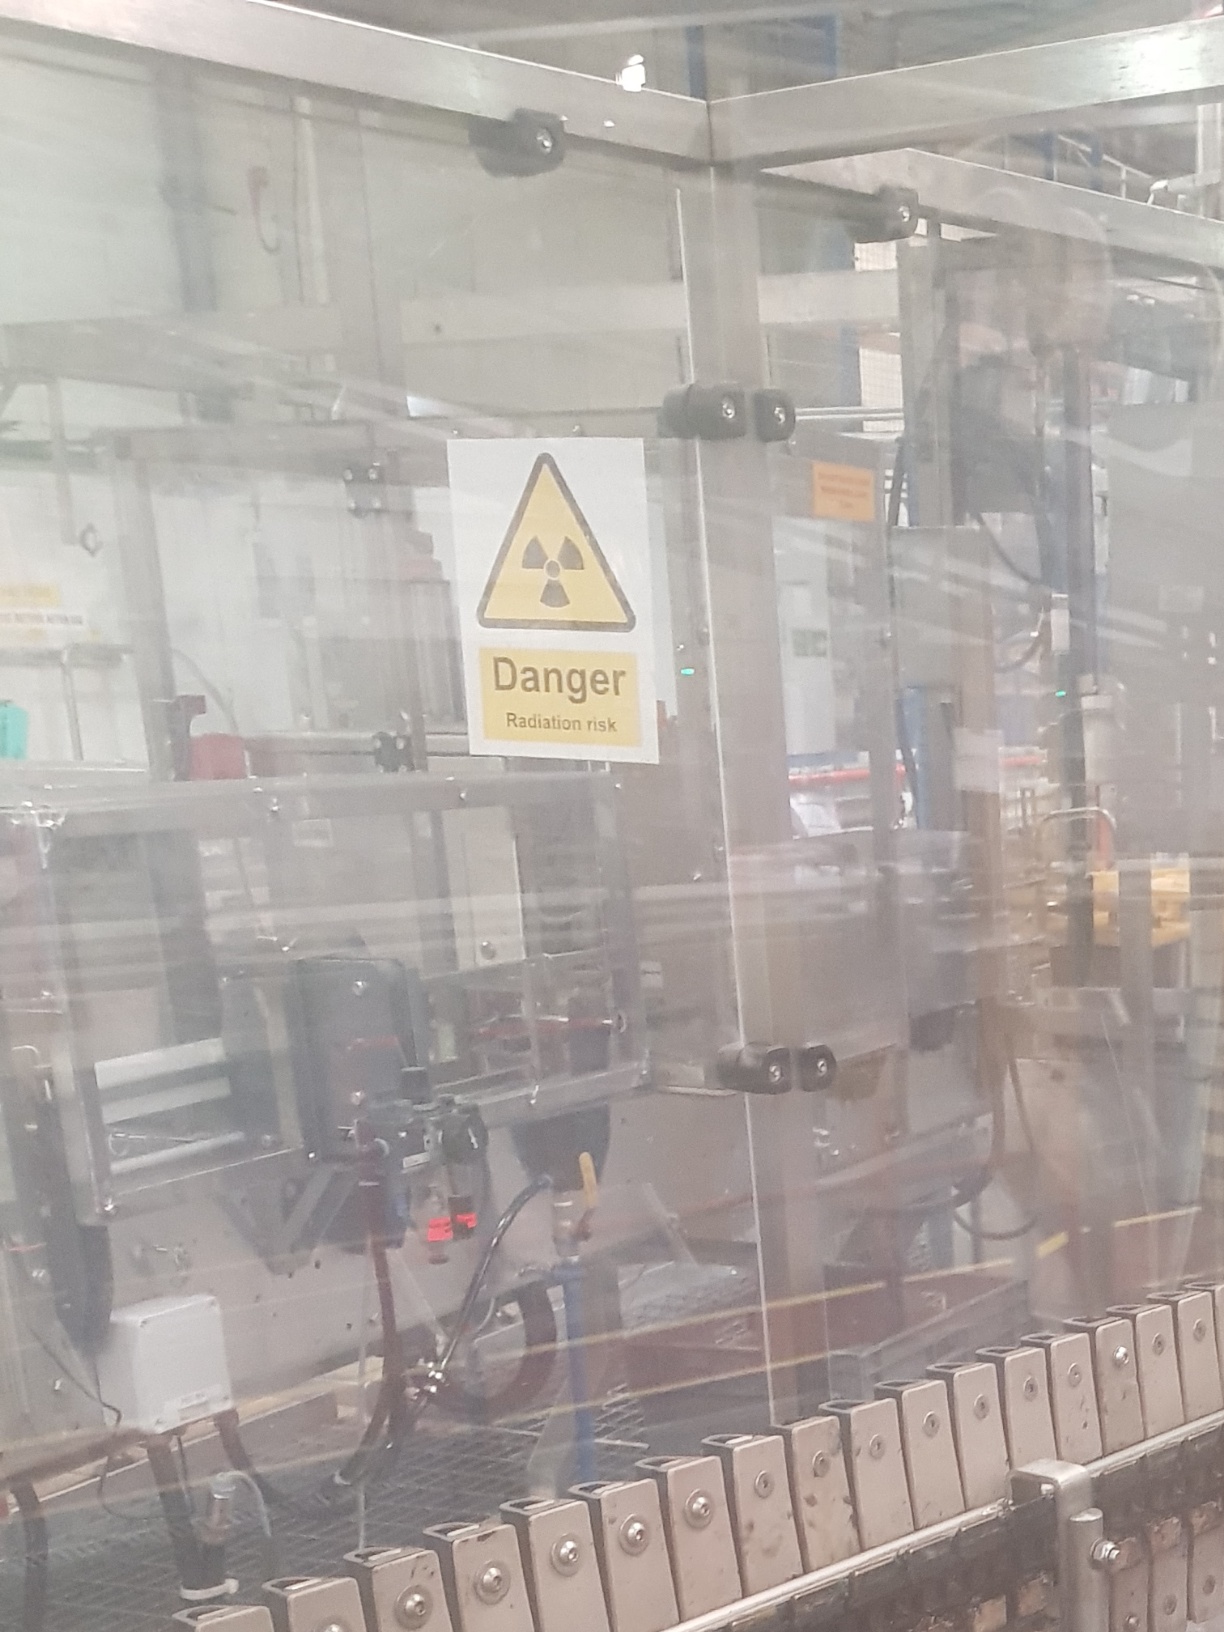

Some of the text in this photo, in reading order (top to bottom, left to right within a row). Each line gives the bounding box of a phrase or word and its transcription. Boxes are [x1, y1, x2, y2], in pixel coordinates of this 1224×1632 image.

[493, 656, 626, 704] Danger
[506, 712, 618, 732] Radiation risk
